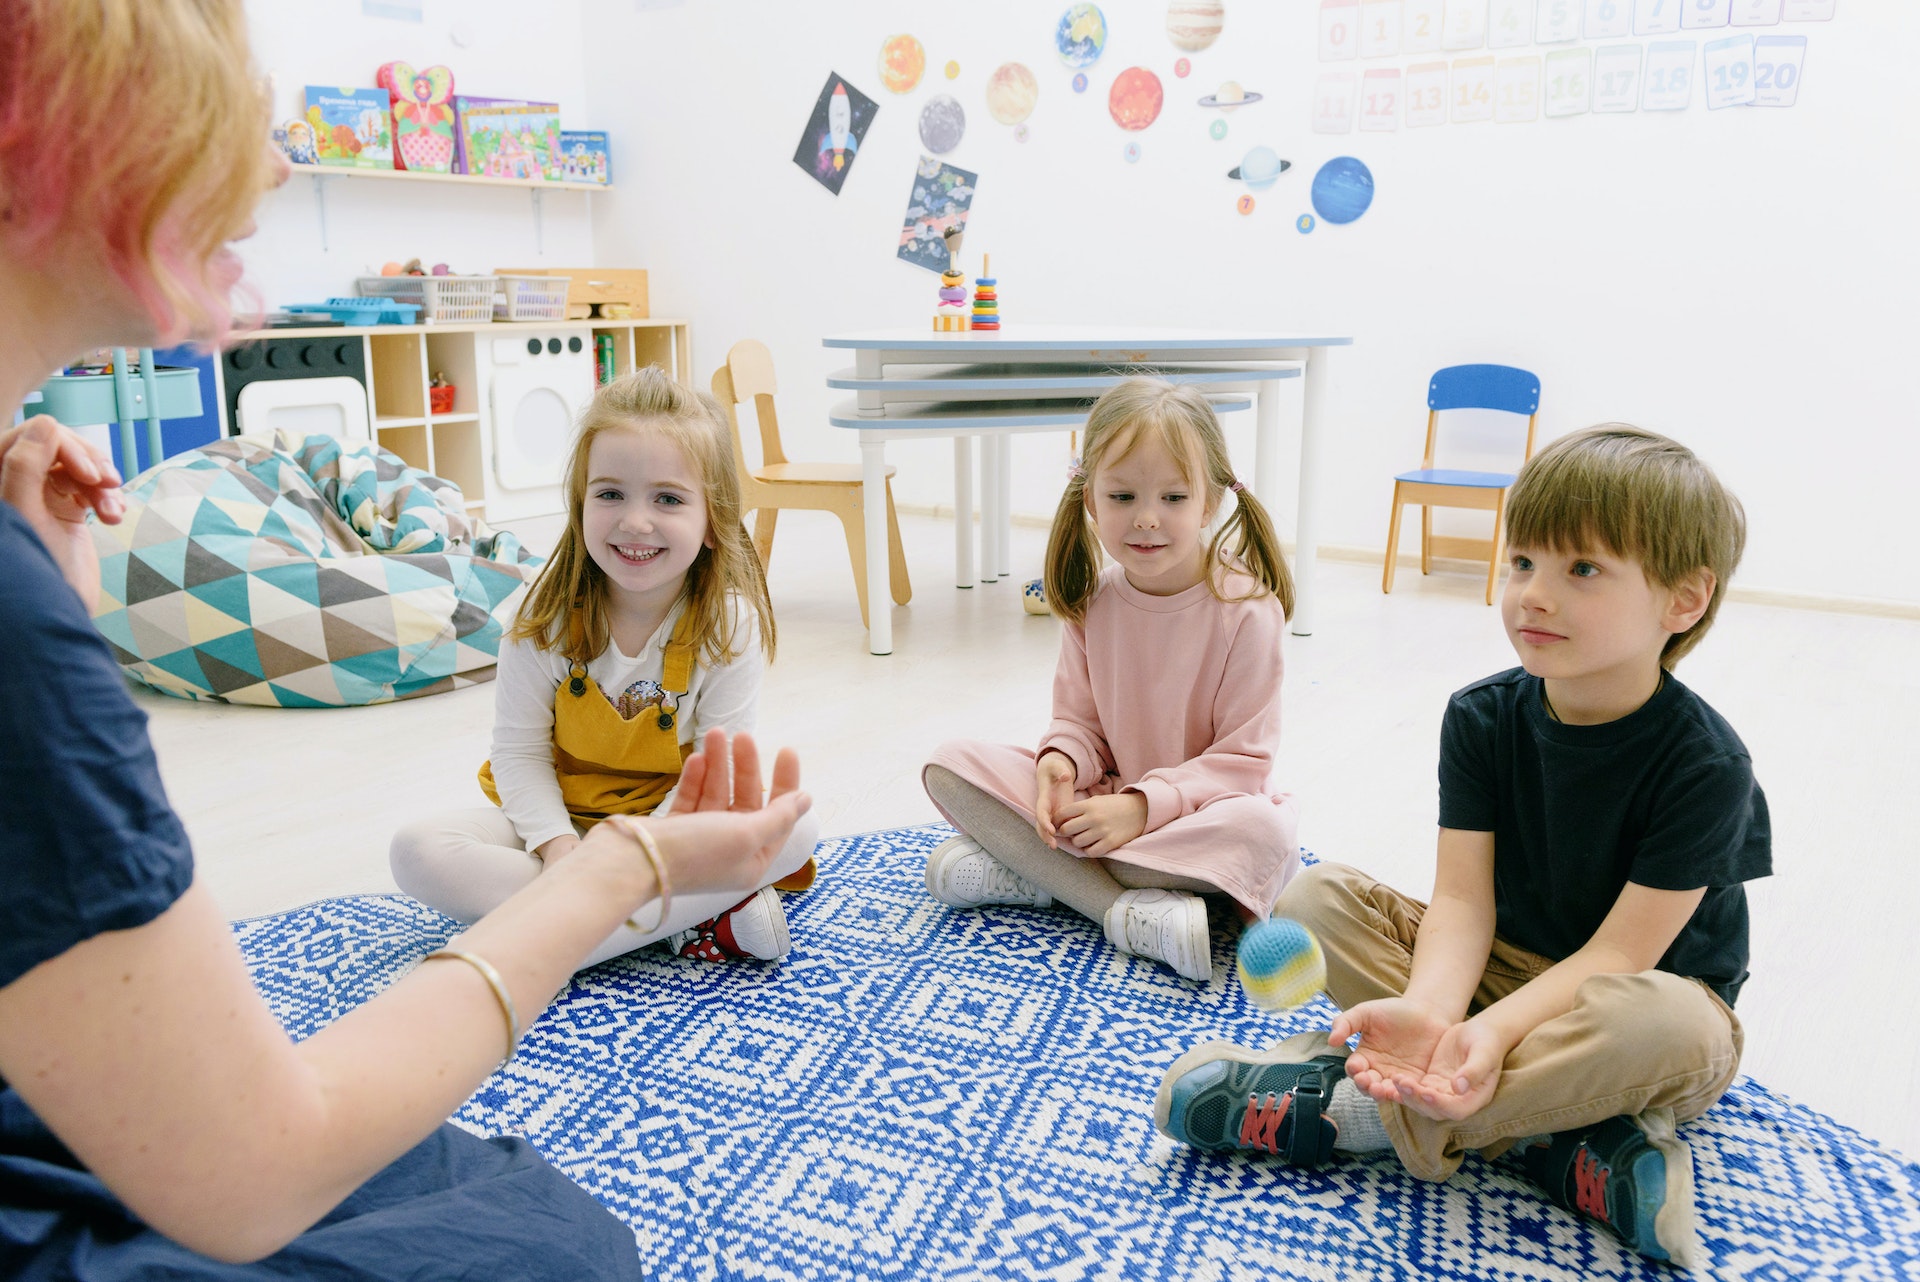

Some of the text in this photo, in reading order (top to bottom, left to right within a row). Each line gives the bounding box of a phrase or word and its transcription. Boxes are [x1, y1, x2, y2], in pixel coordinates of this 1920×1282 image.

[1415, 13, 1431, 37] 2
[1455, 8, 1473, 33] 3
[1499, 4, 1519, 31] 4
[1549, 0, 1568, 26] 5
[1329, 22, 1347, 46] 0
[1375, 17, 1387, 42] 1
[1179, 62, 1186, 73] 5
[1648, 66, 1688, 93] 18
[1713, 61, 1749, 91] 19
[1754, 62, 1797, 89] 20
[1456, 80, 1490, 106] 14
[1501, 81, 1535, 107] 15
[1551, 72, 1585, 100] 16
[1600, 70, 1634, 97] 17
[1319, 95, 1345, 118] 11
[1365, 92, 1396, 116] 12
[1411, 86, 1442, 111] 13
[1215, 124, 1222, 134] 6
[1129, 146, 1136, 156] 4
[1243, 198, 1250, 209] 7
[1301, 217, 1310, 229] 8
